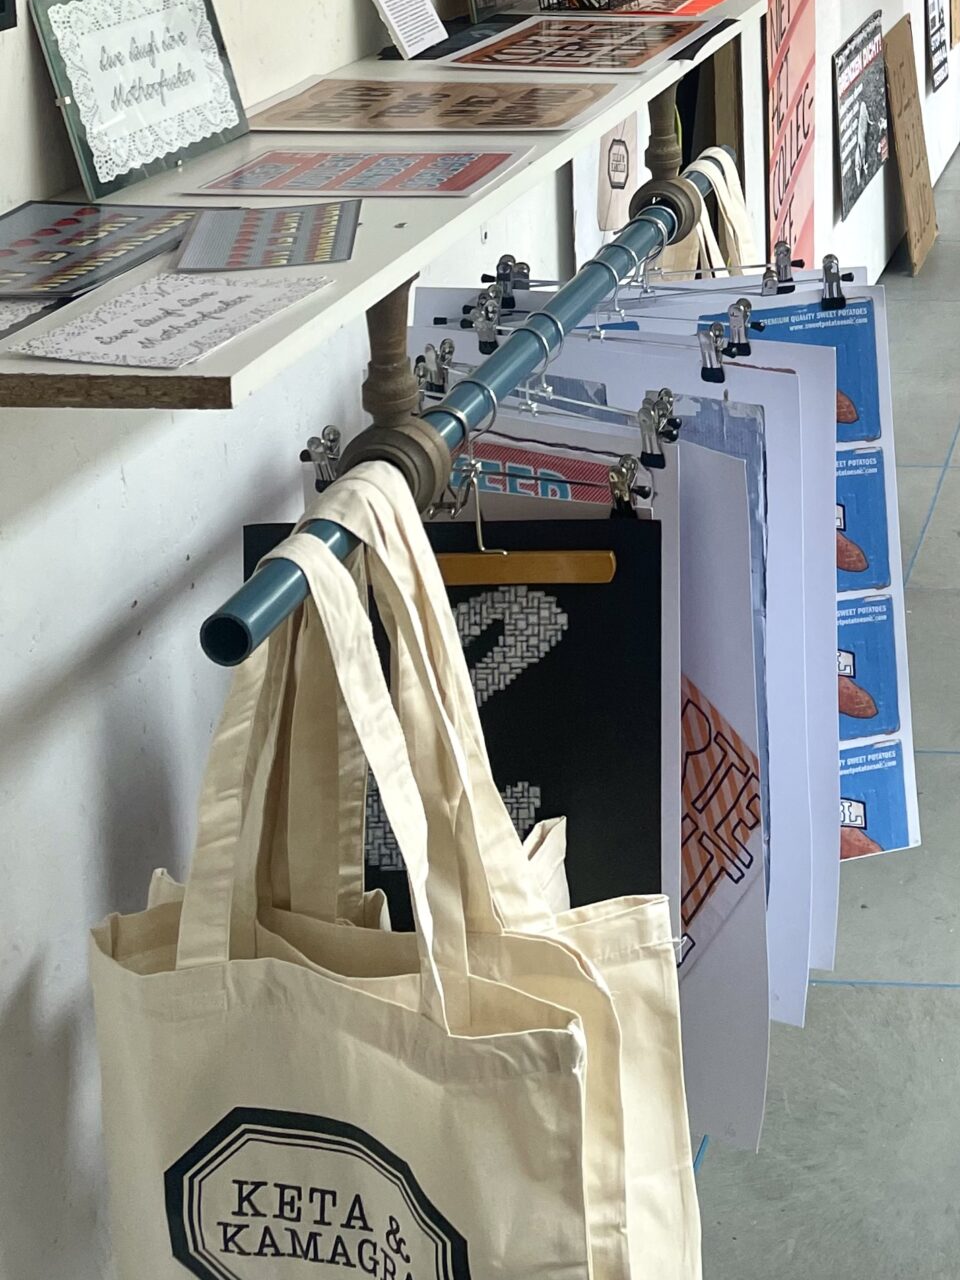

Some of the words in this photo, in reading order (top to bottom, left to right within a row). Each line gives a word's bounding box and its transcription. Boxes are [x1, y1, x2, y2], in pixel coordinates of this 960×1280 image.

[790, 313, 815, 323] QUALITY
[816, 310, 837, 319] SWEET
[838, 307, 868, 317] POTATOES
[847, 457, 877, 467] POTATOES
[857, 605, 887, 615] POTATOES
[847, 755, 867, 765] SWEET
[867, 750, 896, 762] POTATOES
[231, 1178, 374, 1233] KETA
[385, 1214, 411, 1265] &
[216, 1221, 413, 1280] KAMAGR
